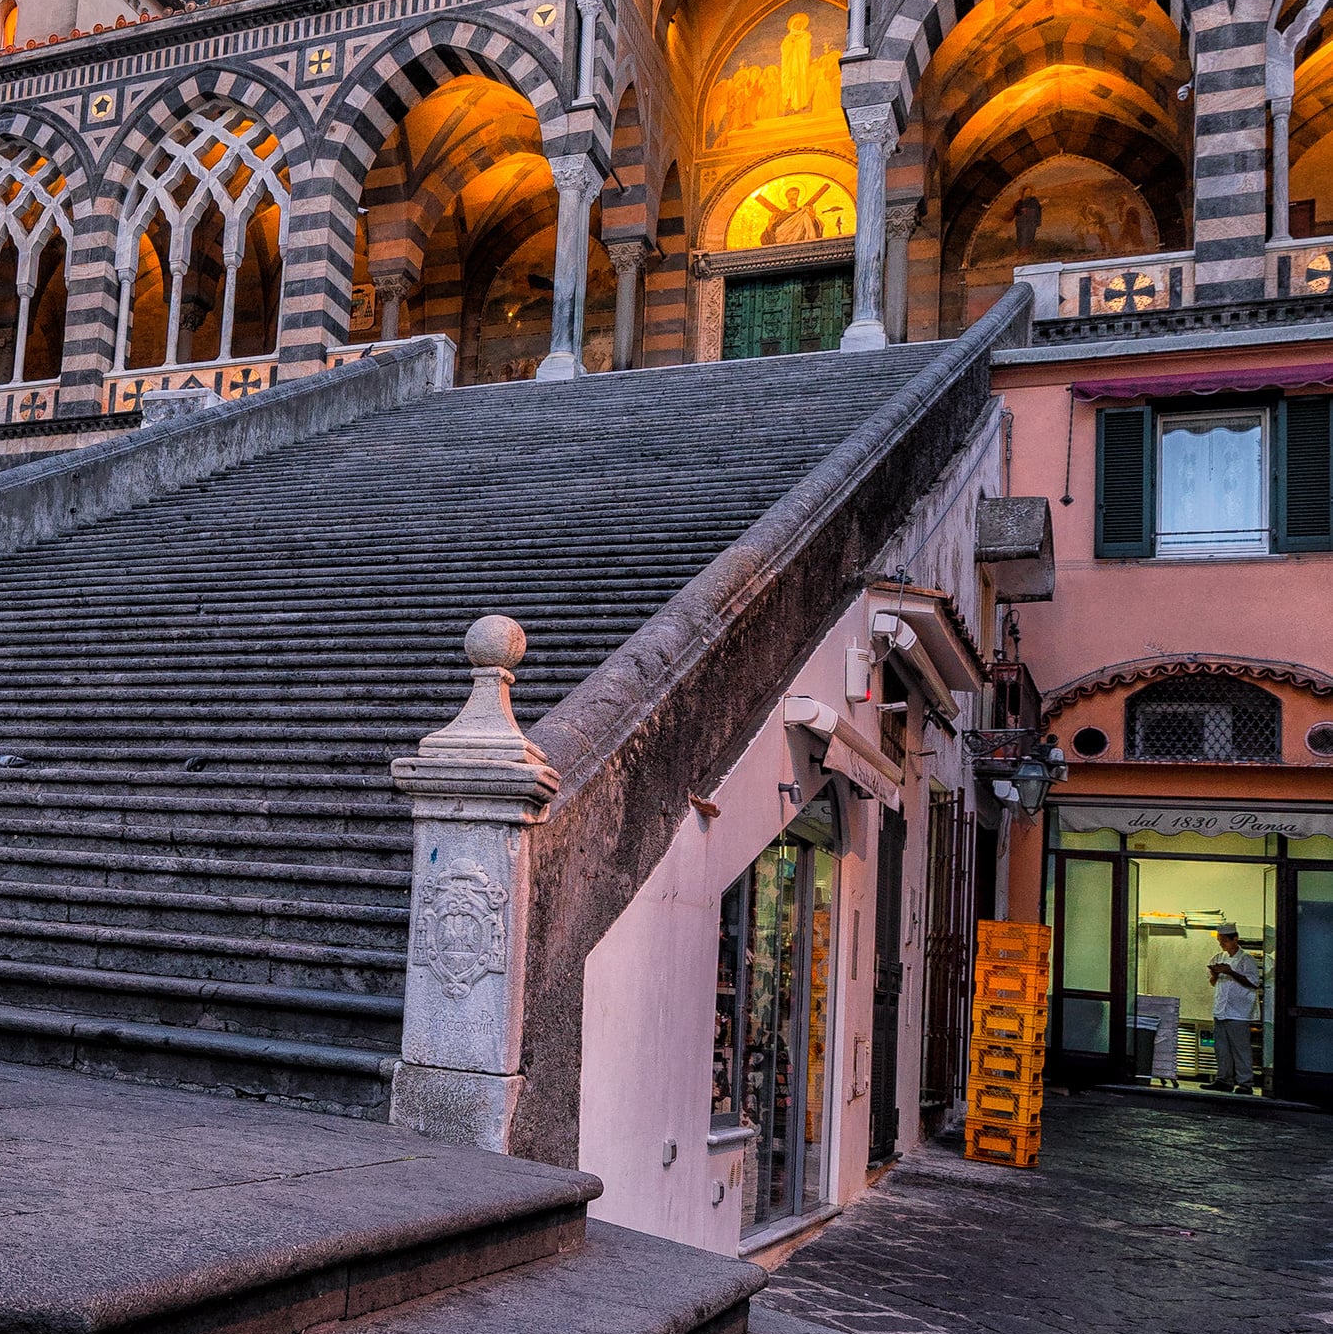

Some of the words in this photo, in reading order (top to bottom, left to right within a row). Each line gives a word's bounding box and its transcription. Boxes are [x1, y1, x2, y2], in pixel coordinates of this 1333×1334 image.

[1128, 813, 1164, 828] dal
[1171, 816, 1219, 829] 1830
[1229, 813, 1299, 832] Pansa
